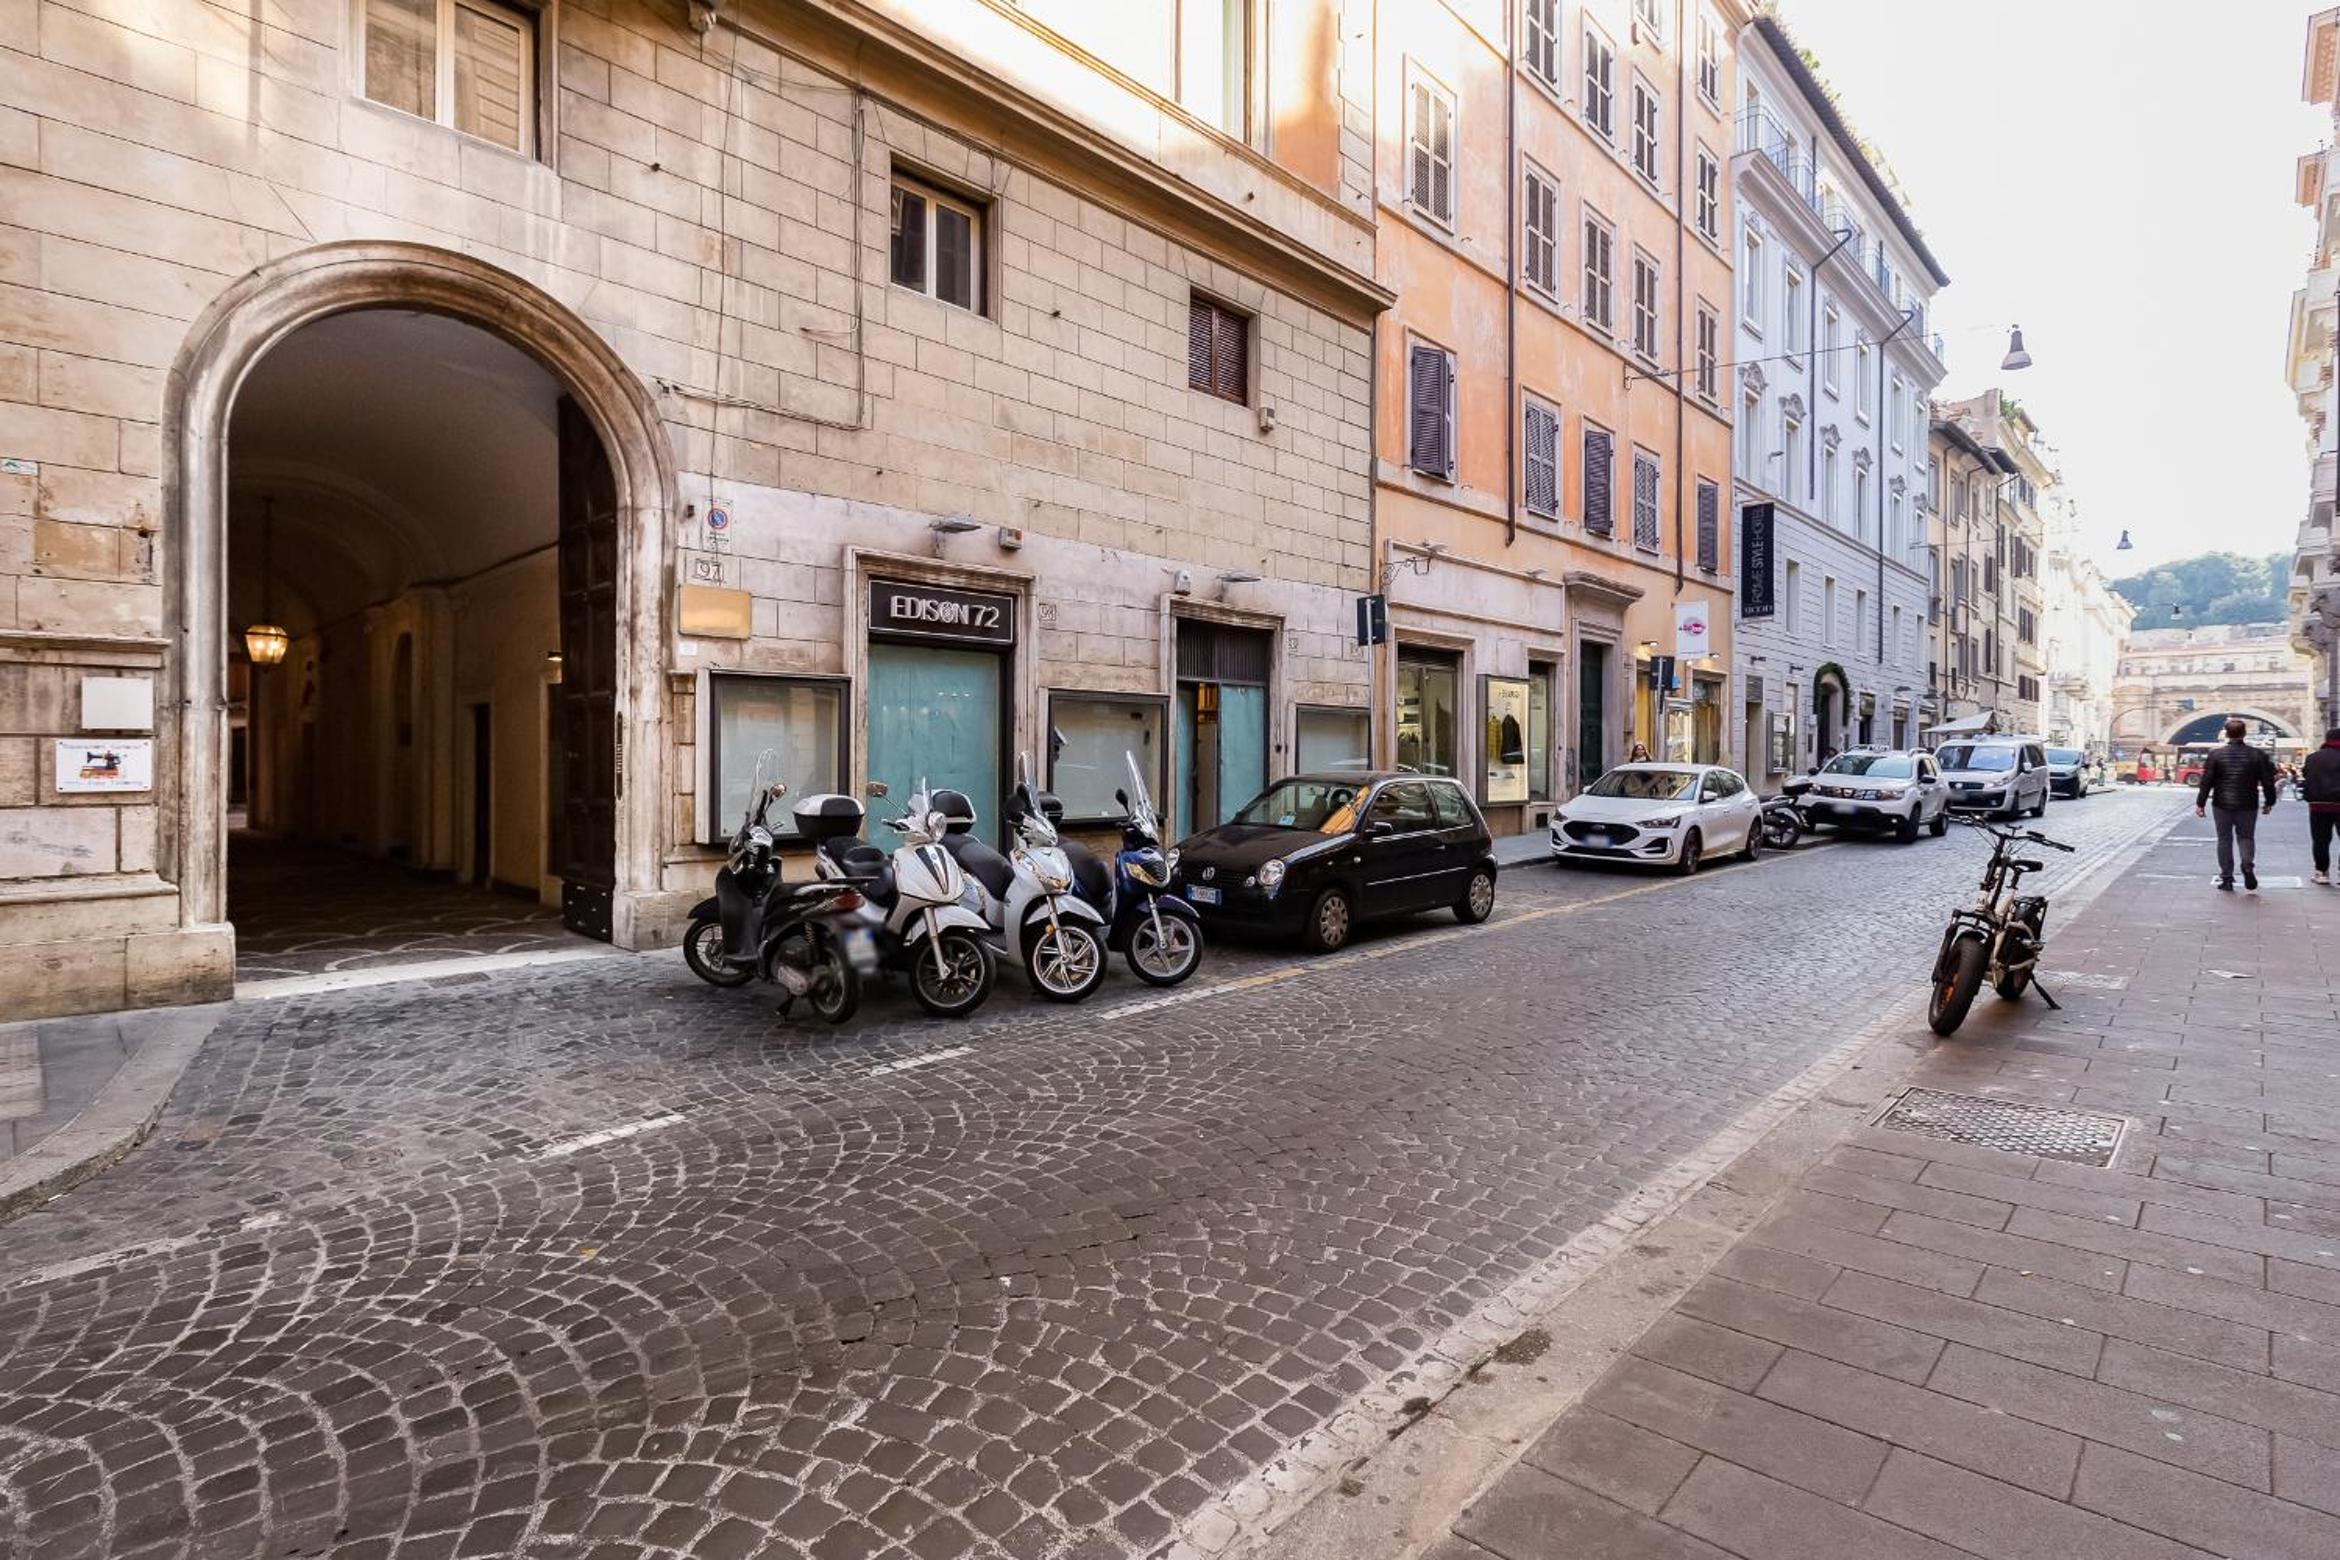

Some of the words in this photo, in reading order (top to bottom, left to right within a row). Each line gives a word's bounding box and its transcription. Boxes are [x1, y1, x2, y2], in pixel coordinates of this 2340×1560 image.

[1752, 541, 1764, 569] STYLE
[890, 595, 969, 625] EDISON
[971, 604, 1000, 628] 72
